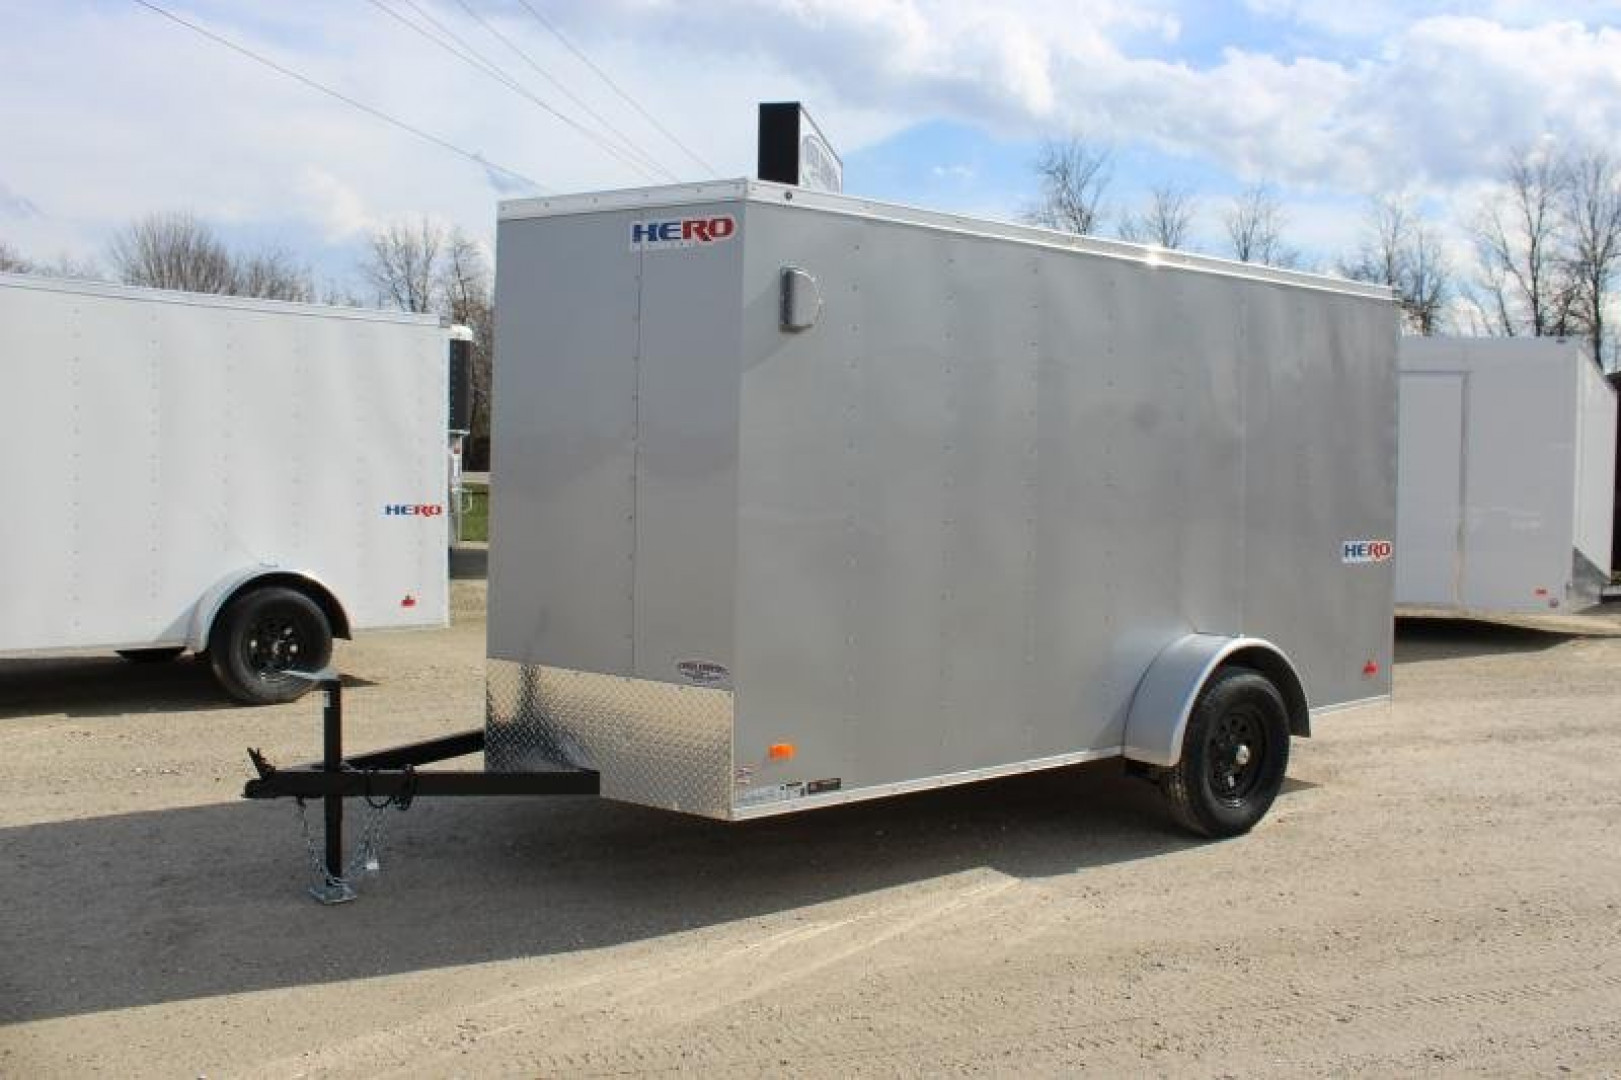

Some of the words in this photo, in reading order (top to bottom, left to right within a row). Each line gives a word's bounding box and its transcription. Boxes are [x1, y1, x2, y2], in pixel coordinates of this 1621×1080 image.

[632, 218, 735, 241] HERO
[385, 505, 441, 516] HERO
[1344, 543, 1391, 557] HERO
